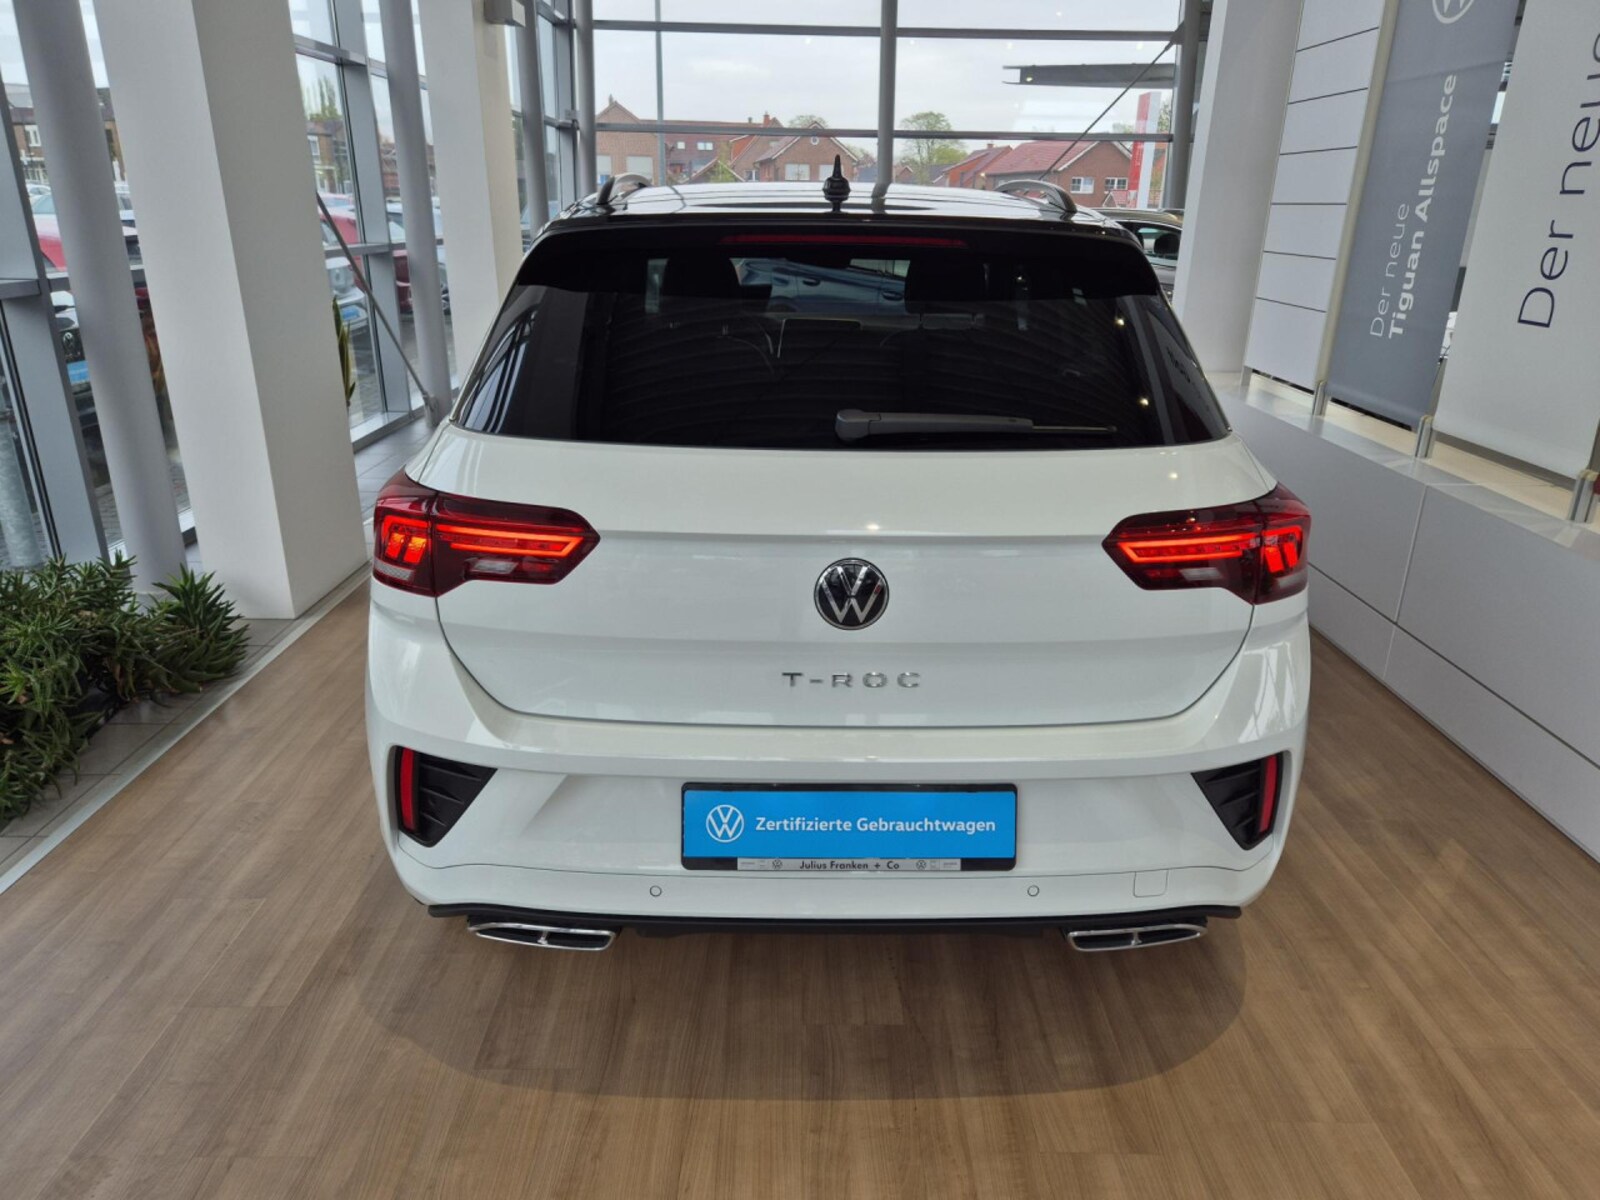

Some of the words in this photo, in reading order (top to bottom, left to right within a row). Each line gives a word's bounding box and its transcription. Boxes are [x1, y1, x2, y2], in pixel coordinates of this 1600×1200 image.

[1388, 231, 1425, 339] Tiguan
[1414, 74, 1457, 222] Allspace
[1517, 218, 1574, 328] Der
[1559, 33, 1600, 195] ne
[1369, 286, 1391, 337] Der
[1384, 203, 1410, 278] neue
[781, 671, 921, 689] T-ROC
[755, 817, 852, 832] Zertifizierte
[856, 817, 996, 835] Gebrauchtwagen
[799, 860, 827, 870] Julius
[830, 860, 868, 870] Franken
[886, 860, 900, 870] Co
